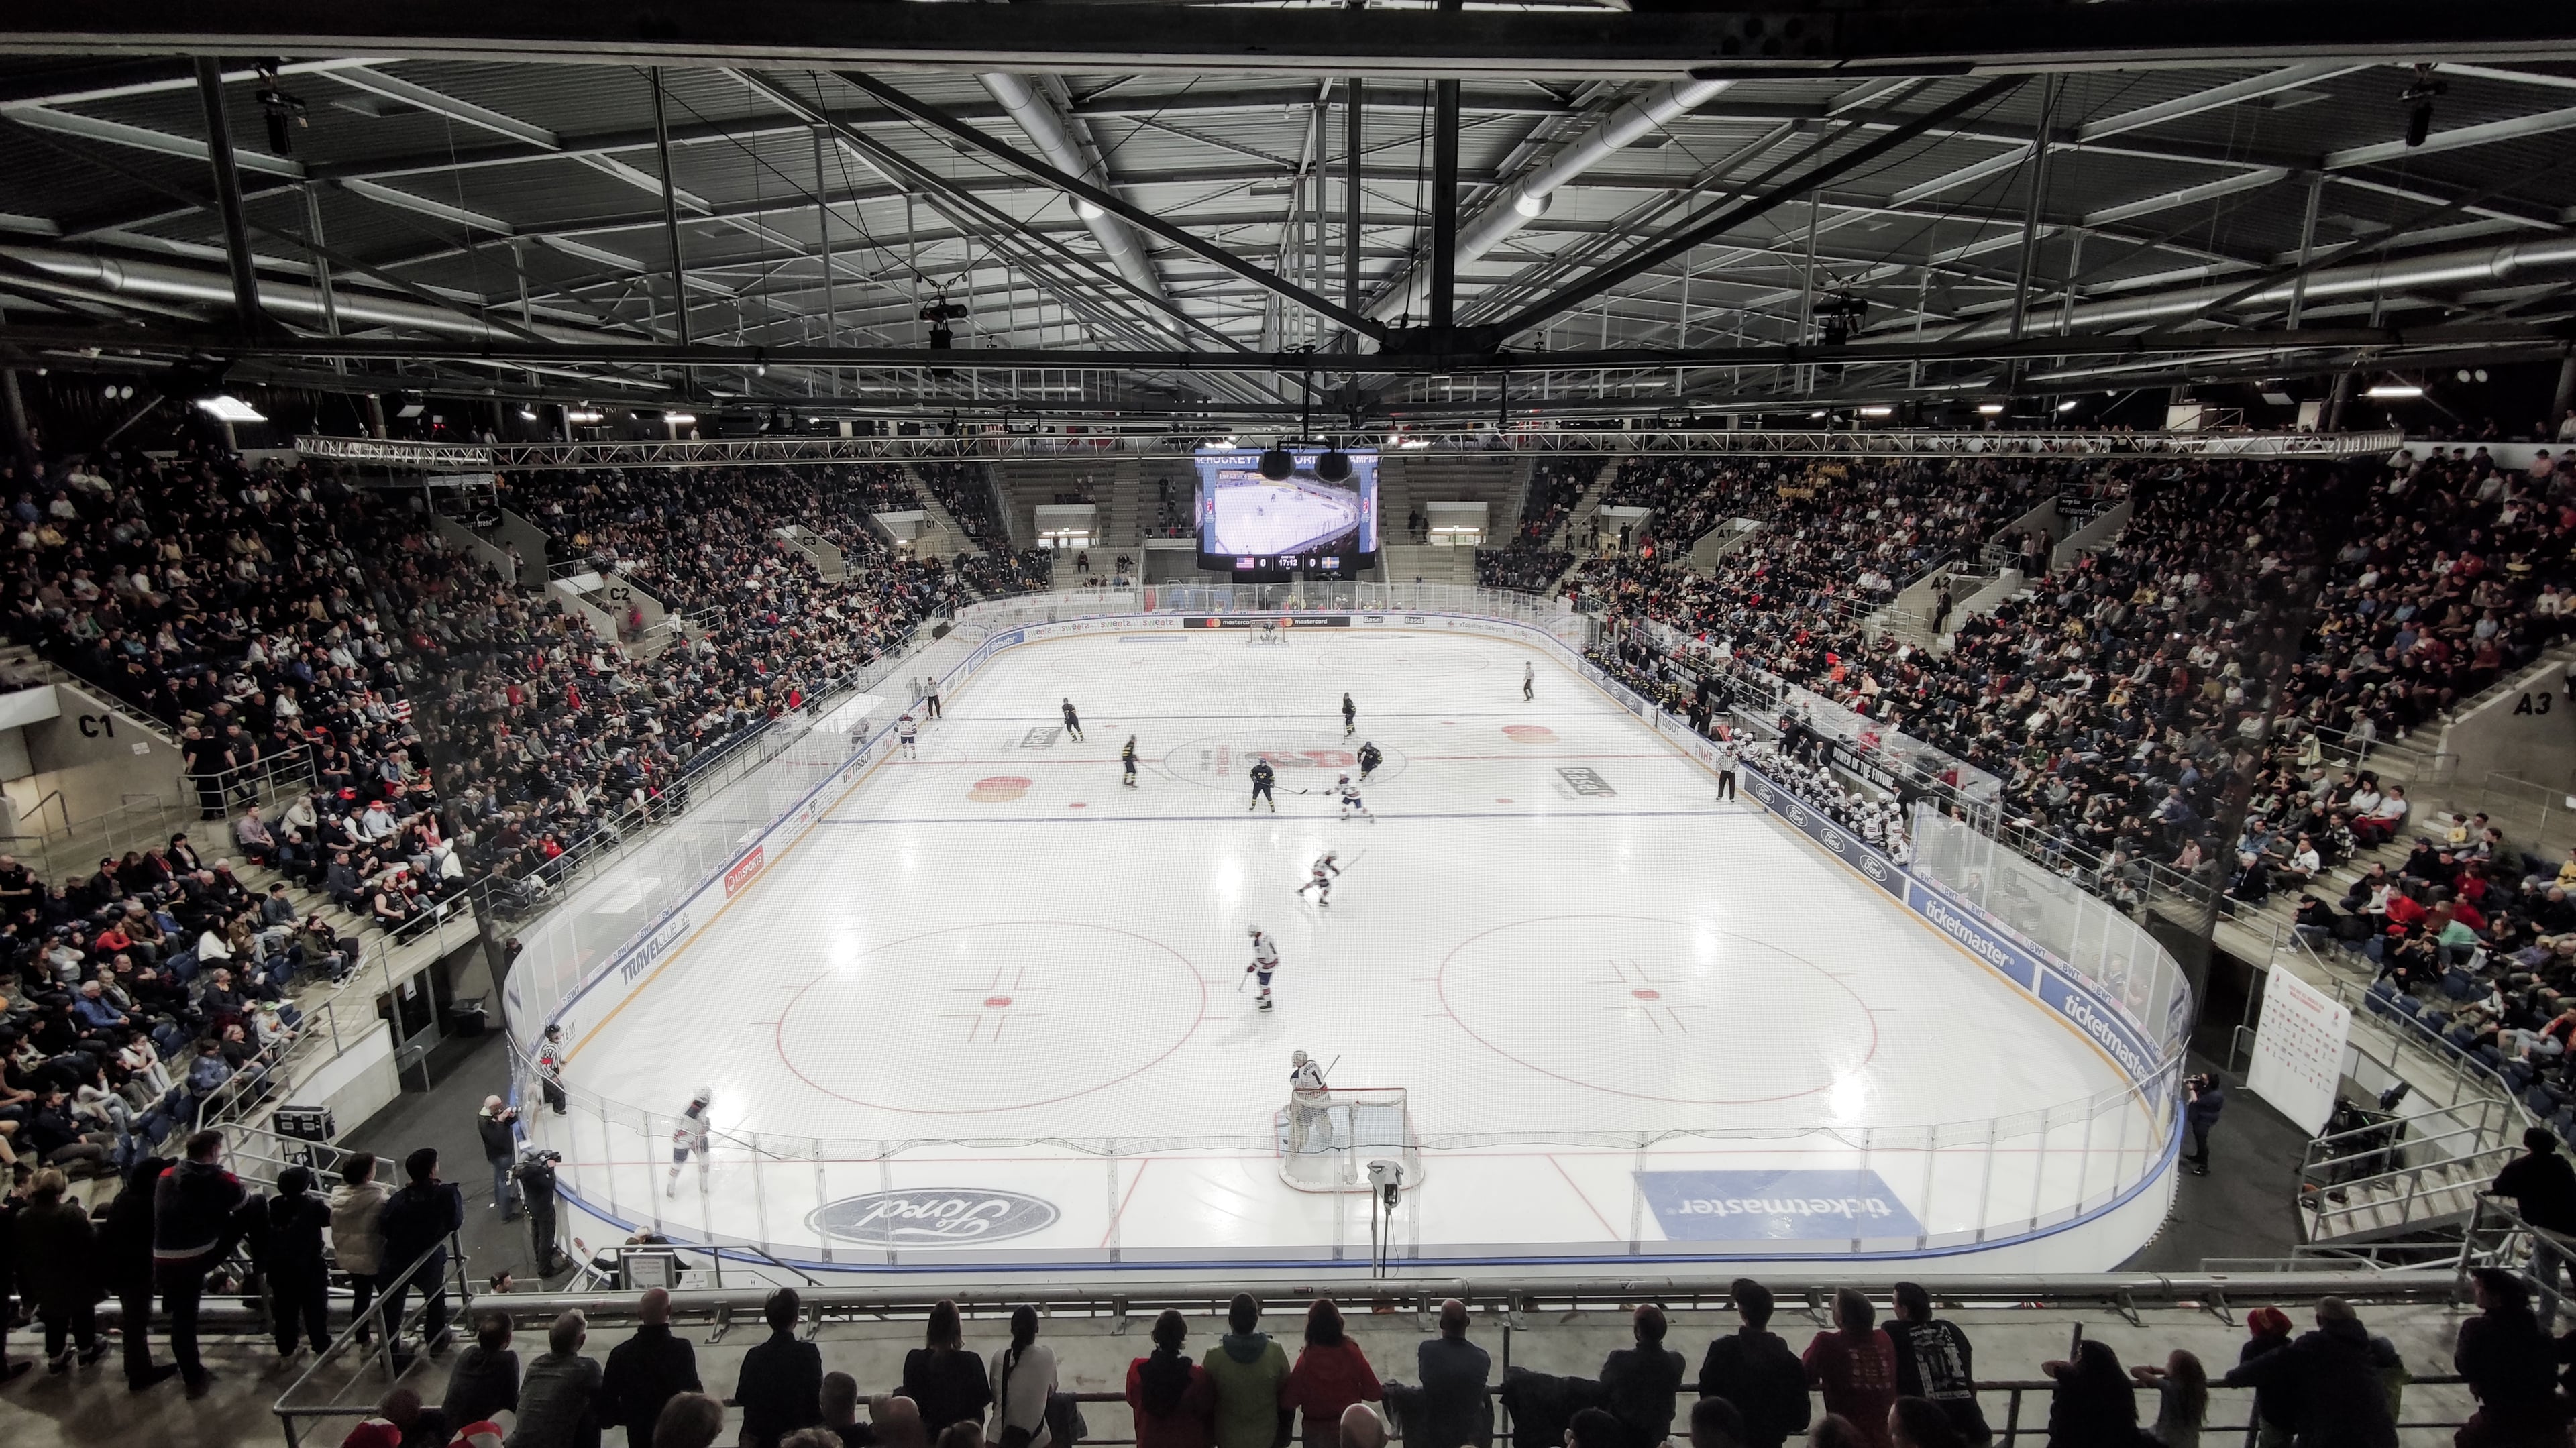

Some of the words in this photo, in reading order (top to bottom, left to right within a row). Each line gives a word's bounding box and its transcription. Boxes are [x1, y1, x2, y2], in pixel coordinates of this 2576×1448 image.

[1207, 456, 1252, 464] HOCKEY
[926, 520, 935, 528] D1
[803, 537, 816, 545] C3
[1717, 529, 1731, 538] A1
[1931, 576, 1951, 590] A2
[610, 588, 630, 600] C2
[2513, 692, 2553, 716] A3
[78, 714, 114, 738] C1
[1659, 714, 1680, 736] TISSOT
[851, 748, 872, 776] TISSOT
[1832, 746, 1851, 767] POWER
[1851, 757, 1860, 771] OF
[1860, 761, 1872, 779] THE
[1871, 767, 1895, 790] FUTURE
[640, 924, 652, 939] BWT
[1926, 899, 2010, 968] ticketmaster
[616, 941, 631, 959] BWT
[2029, 941, 2047, 959] BWT
[2062, 962, 2081, 981] BWT
[566, 984, 580, 1003] BWT
[2096, 987, 2114, 1005] BWT
[1311, 1070, 1322, 1086] 1
[1679, 1198, 1895, 1219] ticketmaster
[853, 1199, 1011, 1237] Ford
